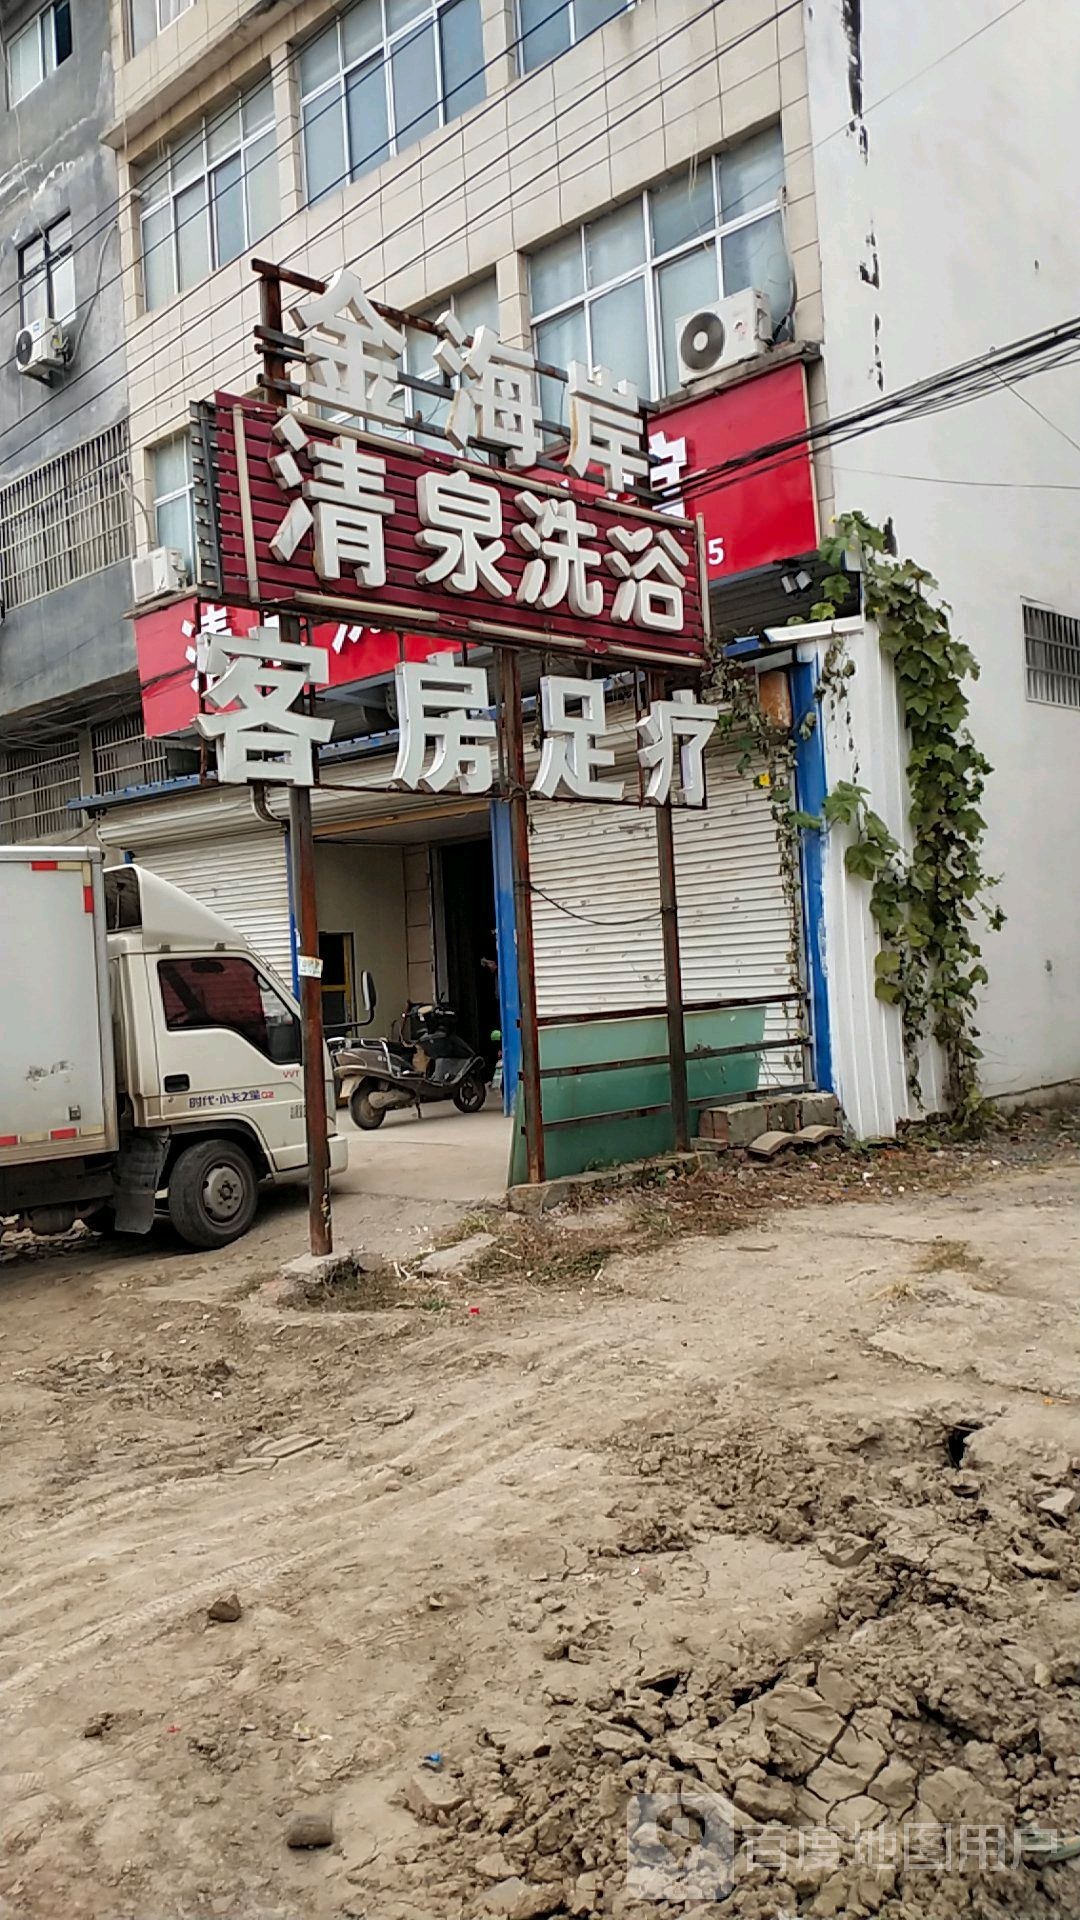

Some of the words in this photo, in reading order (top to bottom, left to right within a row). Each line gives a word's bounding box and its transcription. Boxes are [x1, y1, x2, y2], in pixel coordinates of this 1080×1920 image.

[289, 269, 651, 494] 金海岸
[268, 413, 690, 633] 清泉洗浴
[196, 626, 718, 806] 客房足疗
